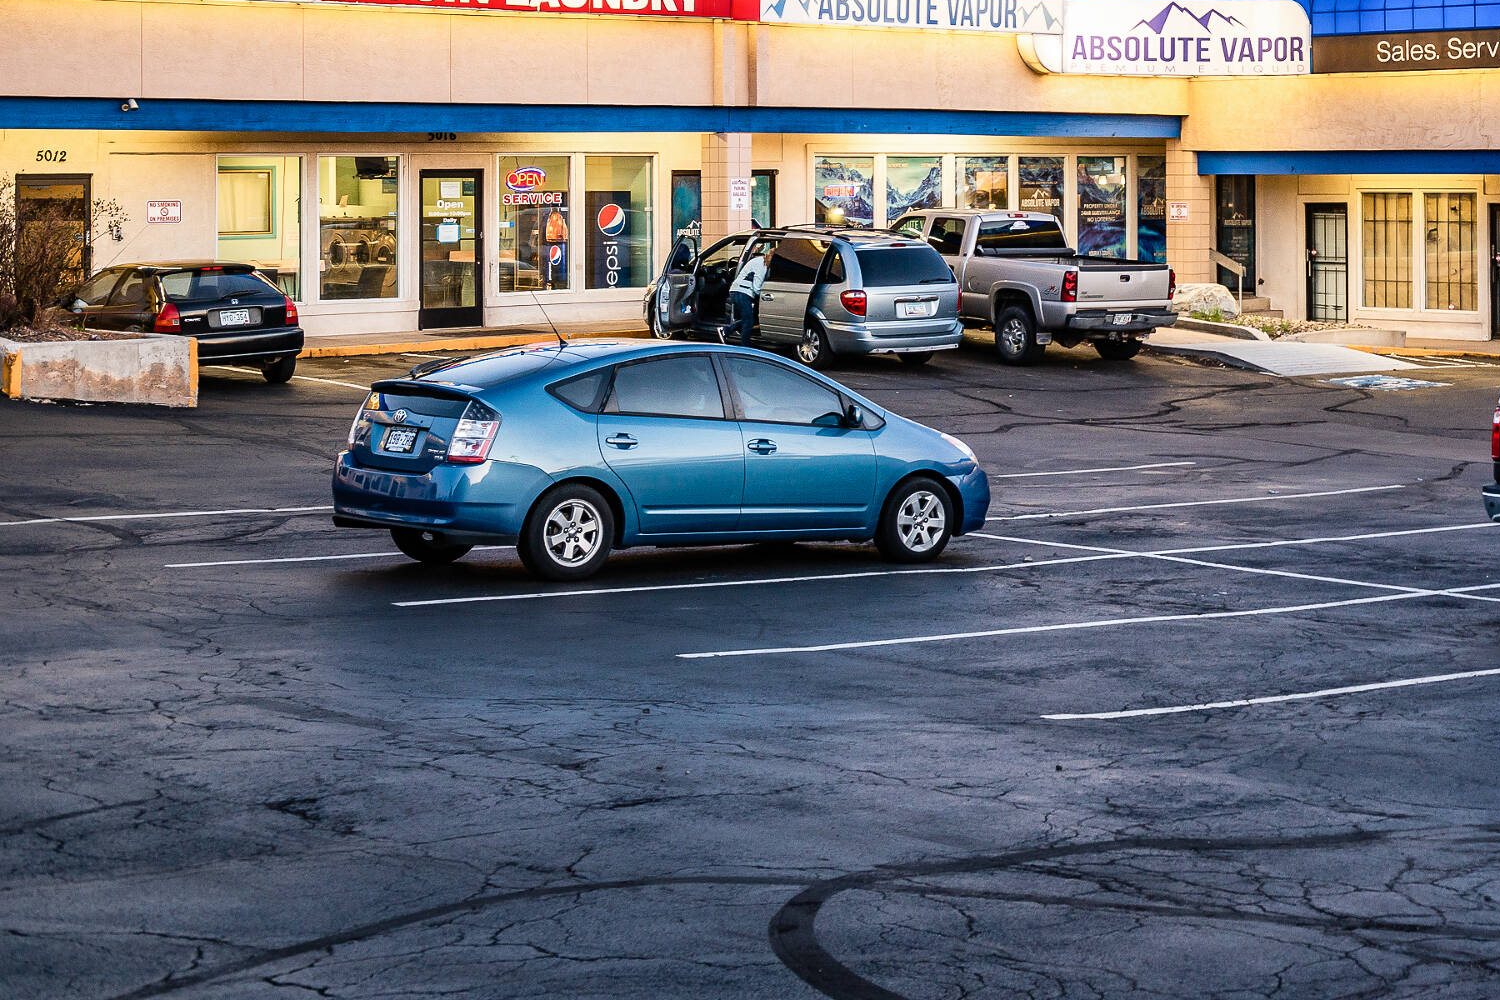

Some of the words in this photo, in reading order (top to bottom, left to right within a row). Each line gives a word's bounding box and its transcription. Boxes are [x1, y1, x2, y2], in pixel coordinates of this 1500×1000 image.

[1072, 34, 1211, 63] ABSOLUTE
[1220, 36, 1304, 63] VAPOR
[1376, 39, 1440, 63] Sales.
[1070, 63, 1176, 73] PREMIUM
[1198, 63, 1305, 73] E-LIQUID
[35, 150, 67, 163] 5012
[507, 171, 545, 187] OPEN
[824, 186, 855, 196] OPEN
[503, 192, 562, 205] SERVICE
[1021, 199, 1045, 207] ABSOLUTE
[1045, 199, 1060, 207] VAPOR
[436, 199, 464, 211] Open
[1141, 206, 1164, 215] ABSOLUTE
[676, 228, 701, 236] ABSOLUTE
[603, 241, 622, 289] epsi
